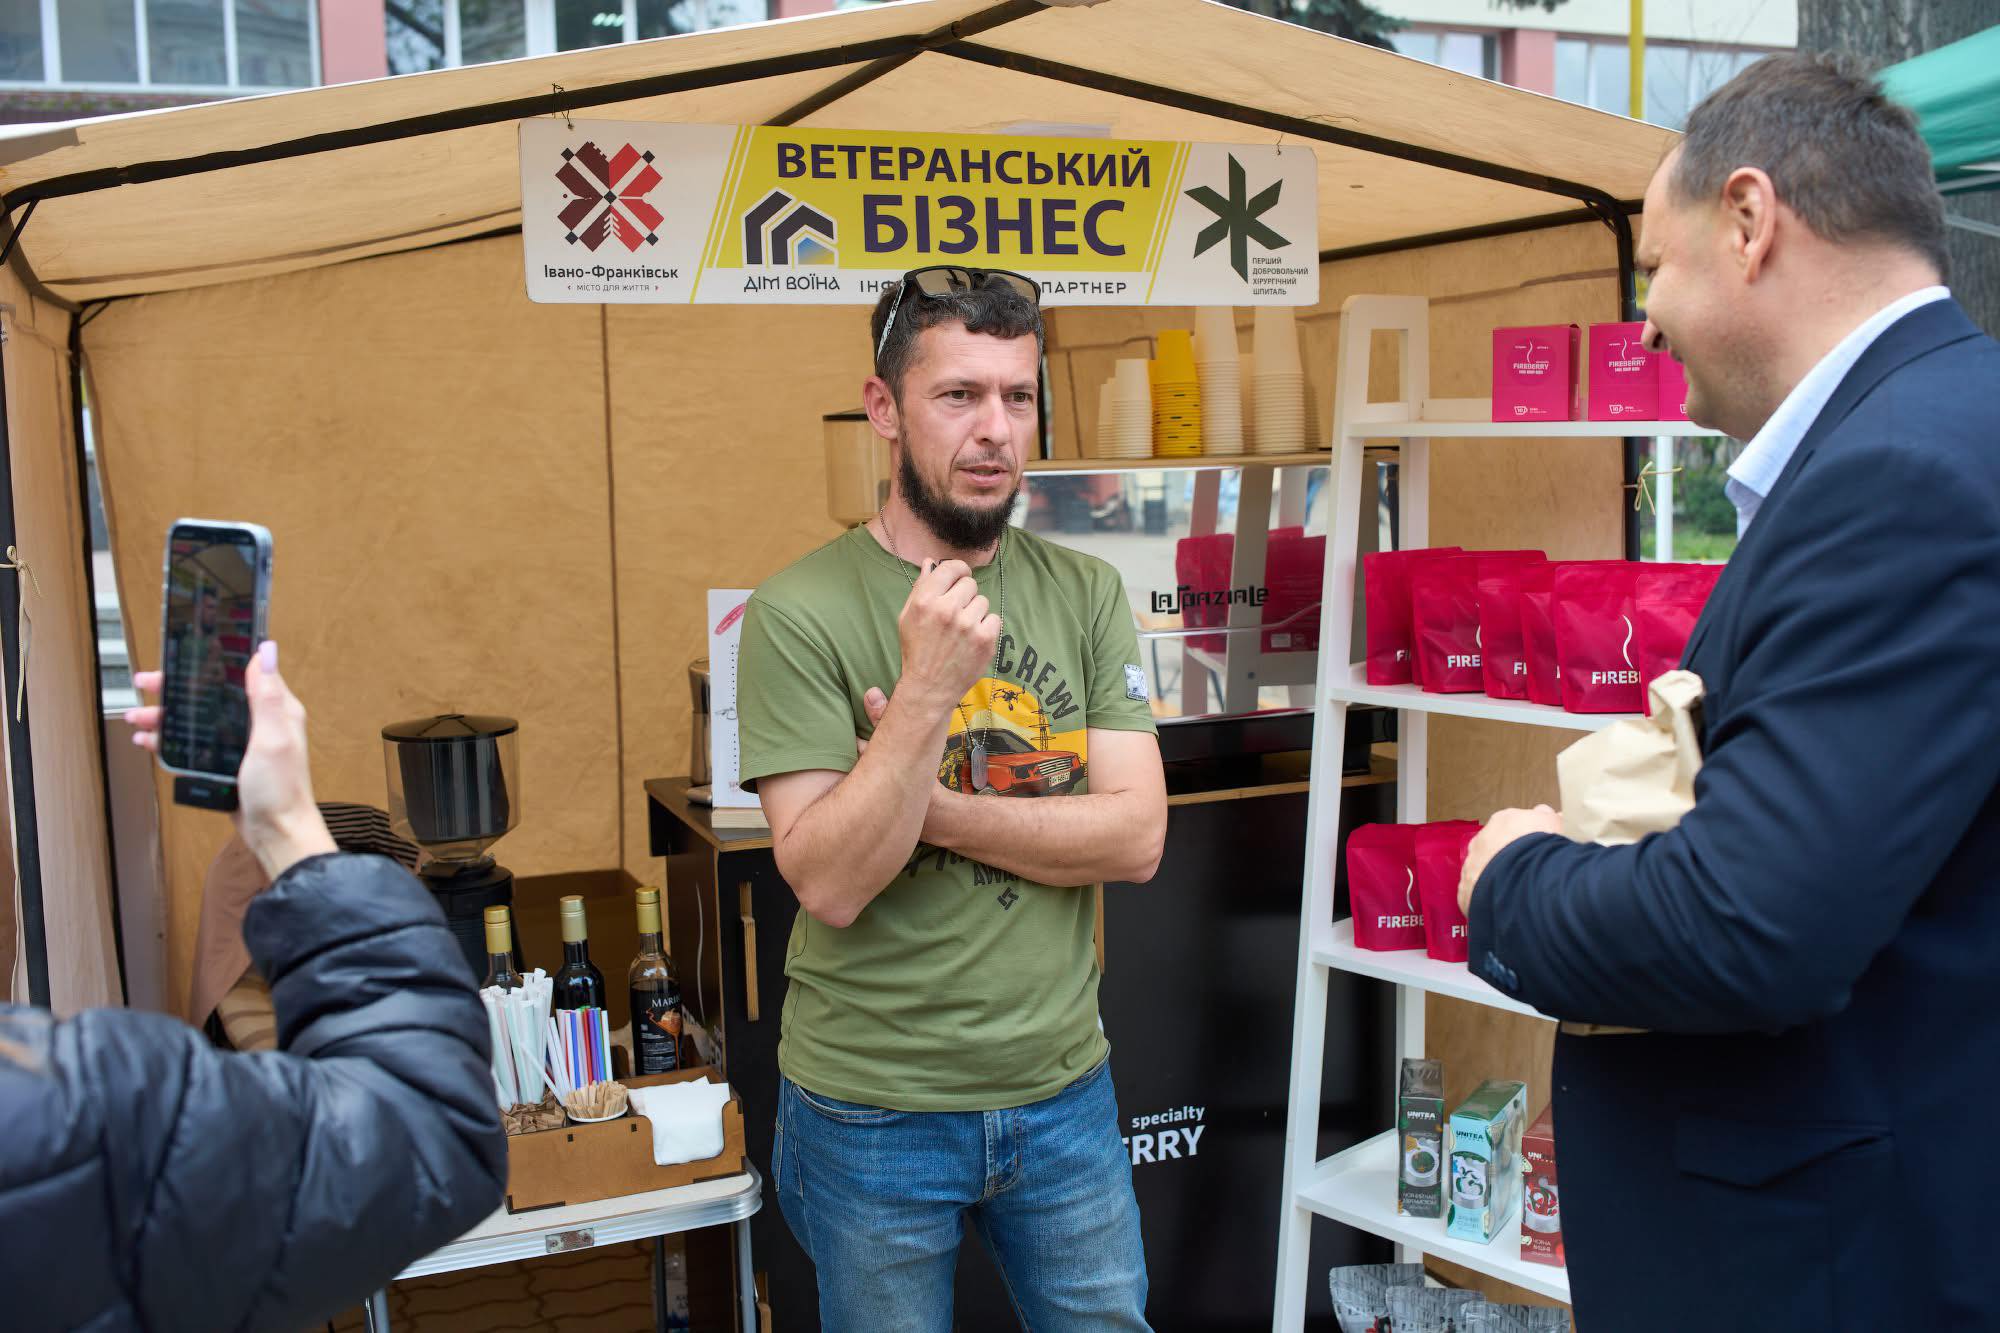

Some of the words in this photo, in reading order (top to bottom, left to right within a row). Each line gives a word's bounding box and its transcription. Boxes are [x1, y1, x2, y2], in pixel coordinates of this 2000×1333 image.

[777, 142, 1151, 188] ВЕТЕРАНСЬКИЙ
[863, 194, 1126, 256] БІЗНЕС
[1252, 257, 1282, 265] ПЕРШИЙ
[544, 264, 679, 281] Івано-Франківськ
[1252, 267, 1309, 275] ДОБРОВОЛЬЧИЙ
[743, 276, 780, 292] ДІМ
[786, 273, 840, 291] ВОЇНА
[1041, 281, 1127, 294] ПАРТНЕР
[1252, 277, 1297, 285] ХІРУРГІЧНИЙ
[576, 284, 601, 292] МІСТО
[603, 284, 620, 292] ДЛЯ
[622, 284, 650, 292] ЖИТТЯ
[1608, 359, 1646, 367] FIREBERRY
[1447, 654, 1482, 668] FIRE
[1513, 662, 1527, 675] FI
[997, 634, 1080, 720] CREW
[1591, 670, 1641, 685] FIREB
[1451, 925, 1468, 938] FI
[1131, 1105, 1206, 1130] specialty
[1456, 1130, 1484, 1140] UNITEA
